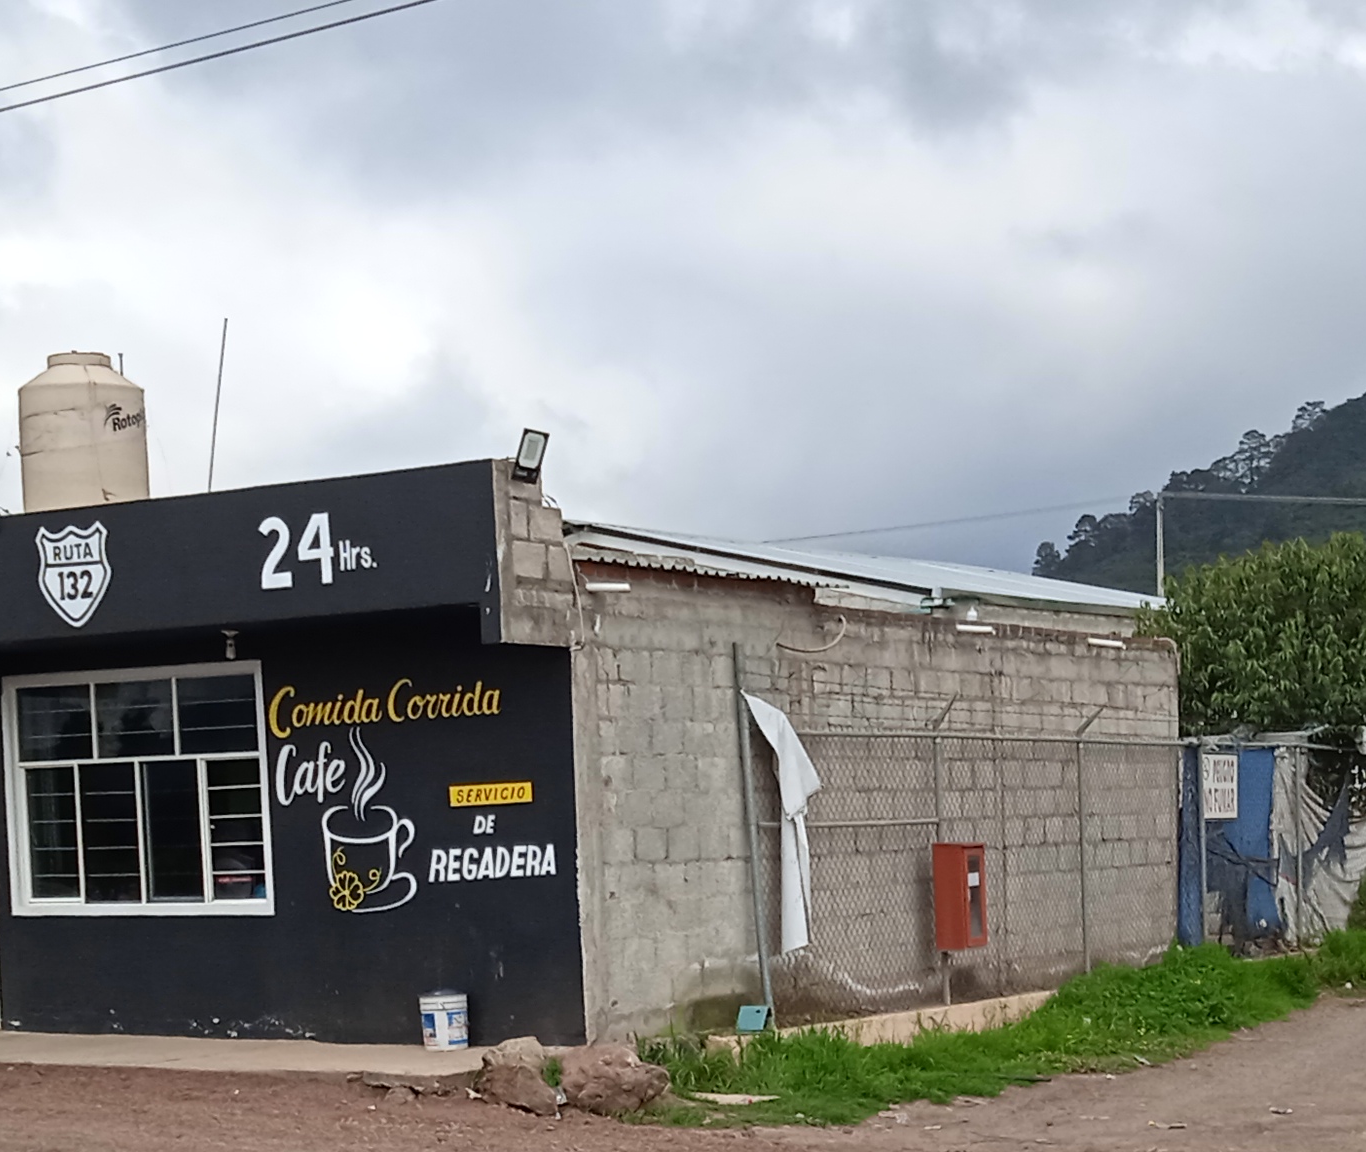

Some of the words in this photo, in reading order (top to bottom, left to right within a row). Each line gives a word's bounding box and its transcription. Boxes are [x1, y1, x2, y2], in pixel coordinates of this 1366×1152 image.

[52, 542, 94, 561] RUTA
[258, 512, 334, 590] 24
[338, 539, 378, 572] Hrs.
[57, 571, 94, 600] 132
[269, 686, 382, 738] Comida
[387, 678, 502, 723] Corrida
[275, 741, 346, 806] Cafe
[456, 786, 526, 804] SERVICIO
[473, 815, 496, 834] DE
[428, 844, 557, 882] REGADERA
